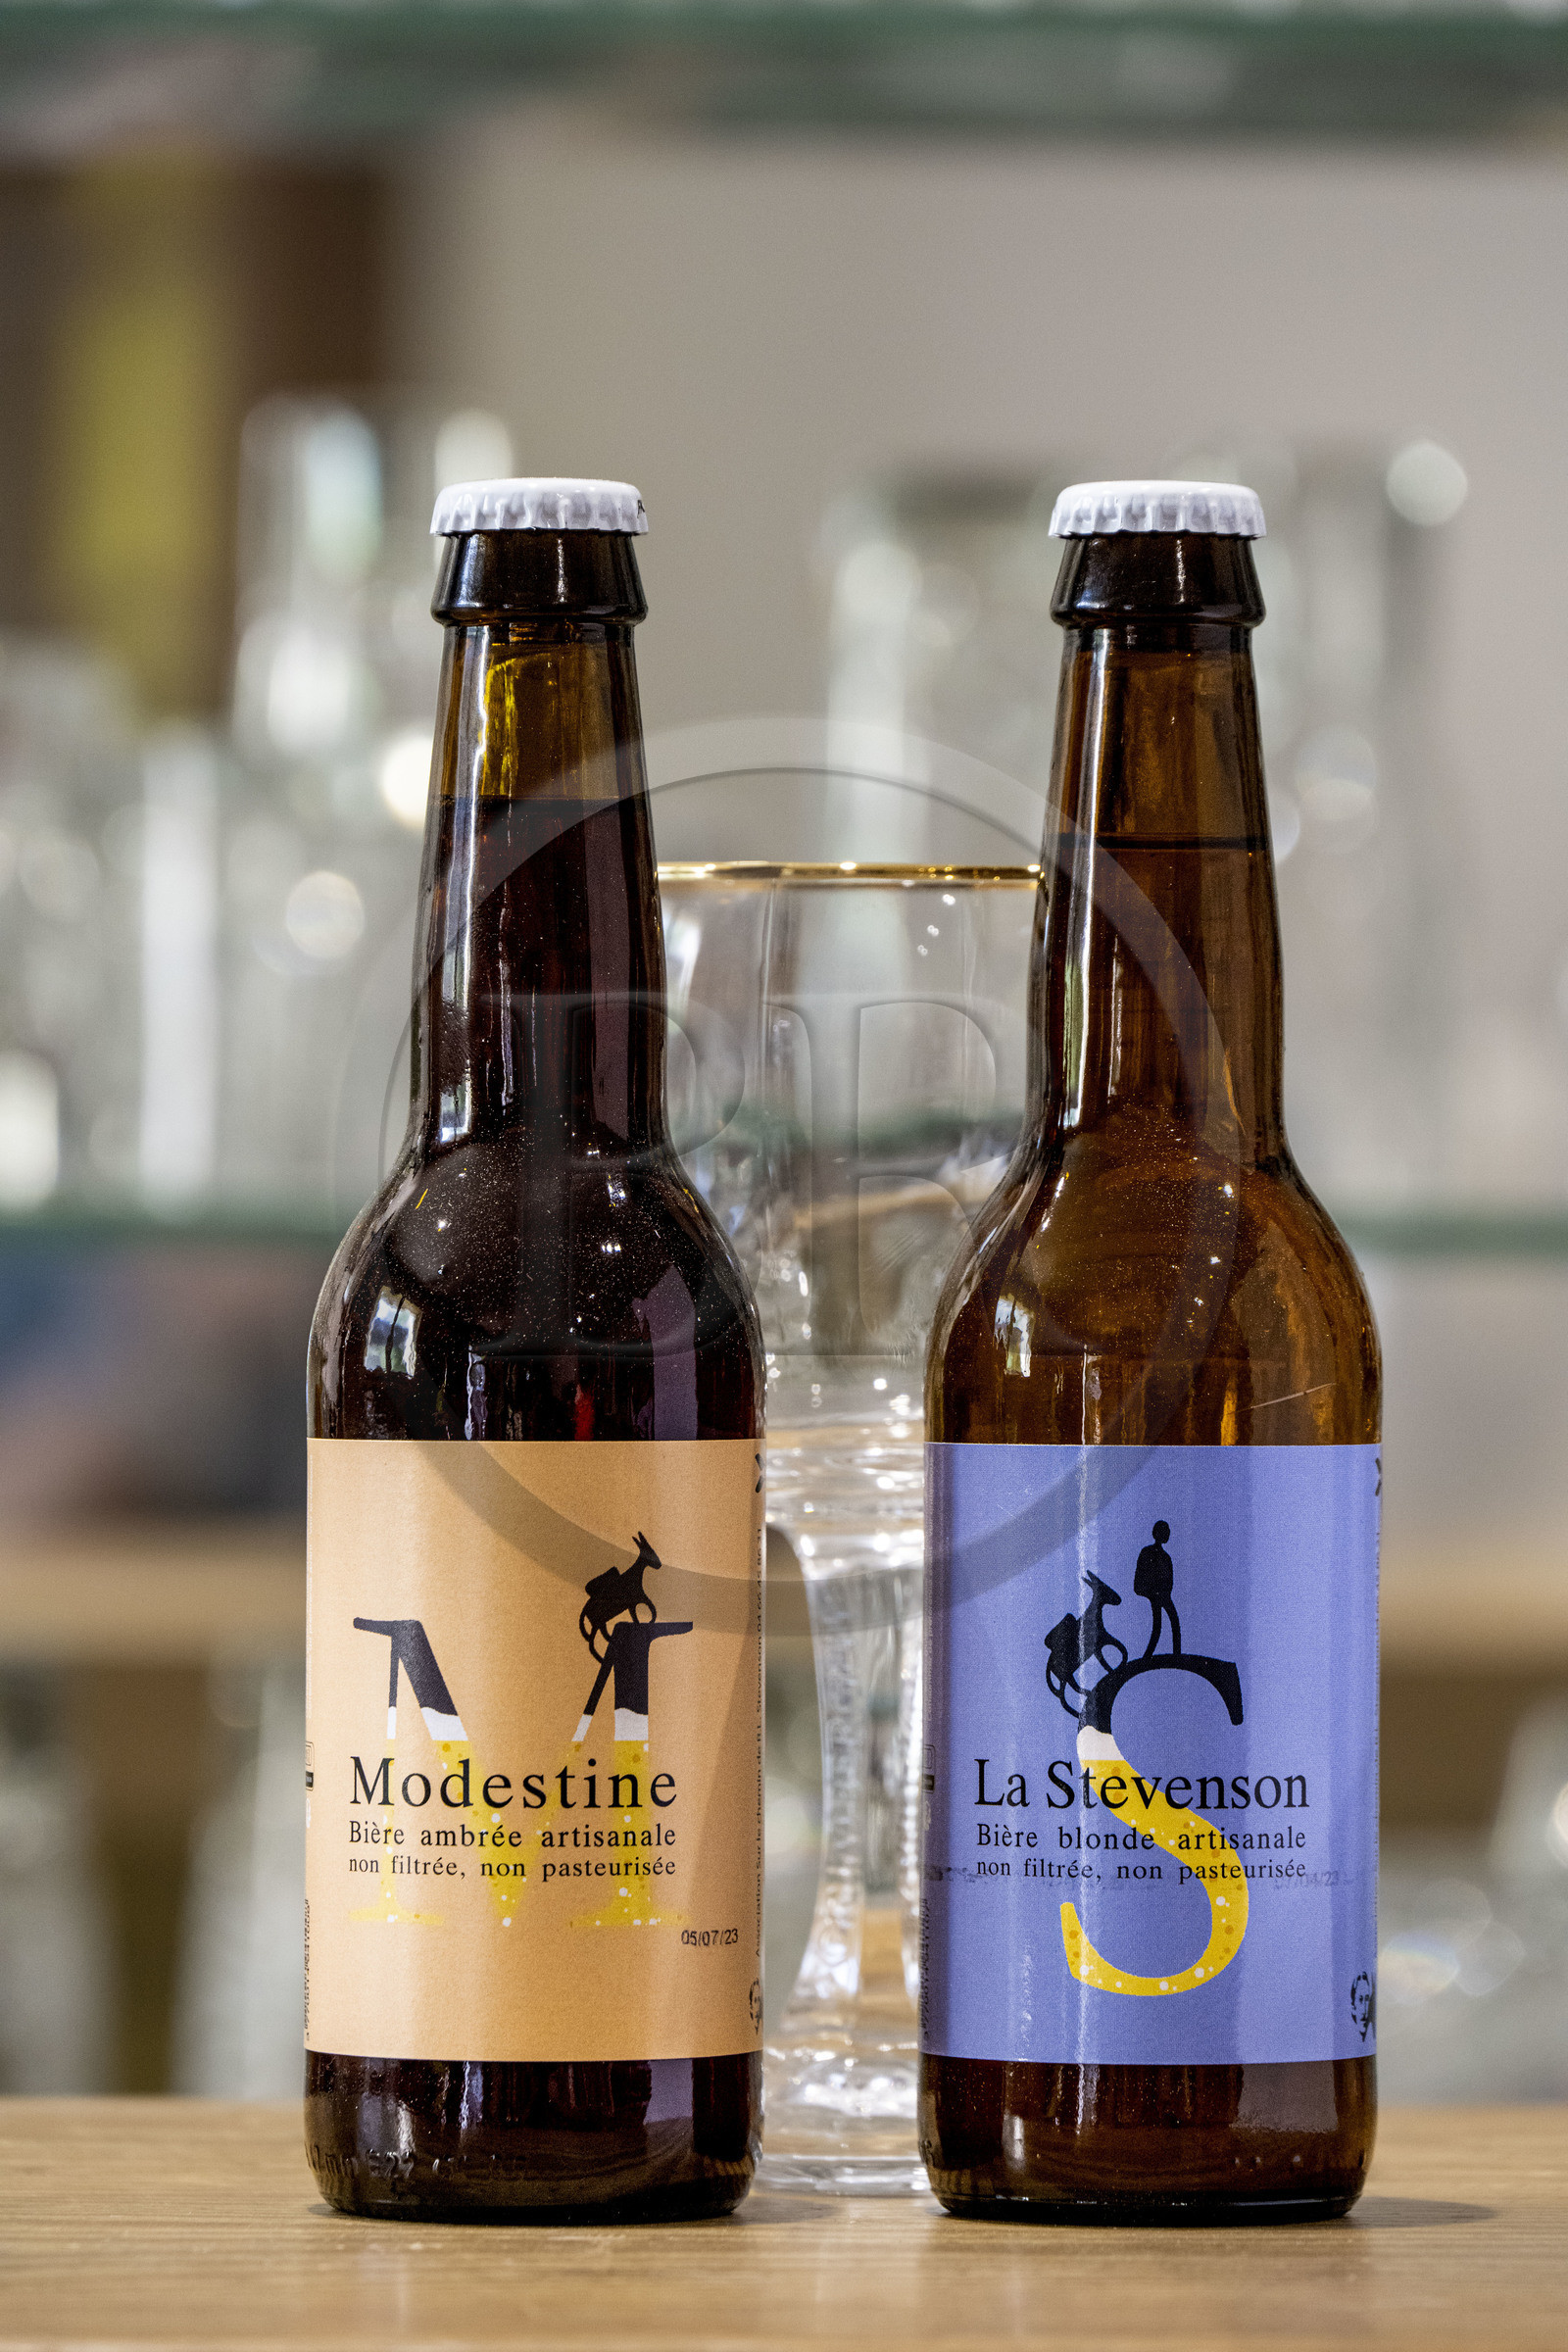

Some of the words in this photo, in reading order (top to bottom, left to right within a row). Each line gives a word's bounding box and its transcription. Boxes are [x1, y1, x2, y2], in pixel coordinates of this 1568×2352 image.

[350, 1756, 677, 1809] Modestine
[973, 1758, 1031, 1808] La
[1046, 1760, 1310, 1810] Stevenson
[349, 1820, 405, 1844] Bière
[420, 1824, 523, 1848] ambrée
[541, 1823, 676, 1848] artisanale
[976, 1823, 1039, 1848] Bière
[1057, 1826, 1155, 1851] blonde
[1177, 1826, 1306, 1850] artisanale
[348, 1857, 380, 1874] non
[391, 1855, 466, 1880] filtrée,
[480, 1862, 526, 1877] non
[542, 1856, 676, 1883] pasteurisée
[976, 1860, 1011, 1877] non
[1023, 1857, 1102, 1883] filtrée,
[1115, 1865, 1163, 1880] non
[1178, 1858, 1307, 1886] pasteurisée
[680, 1927, 740, 1947] 05/07/23
